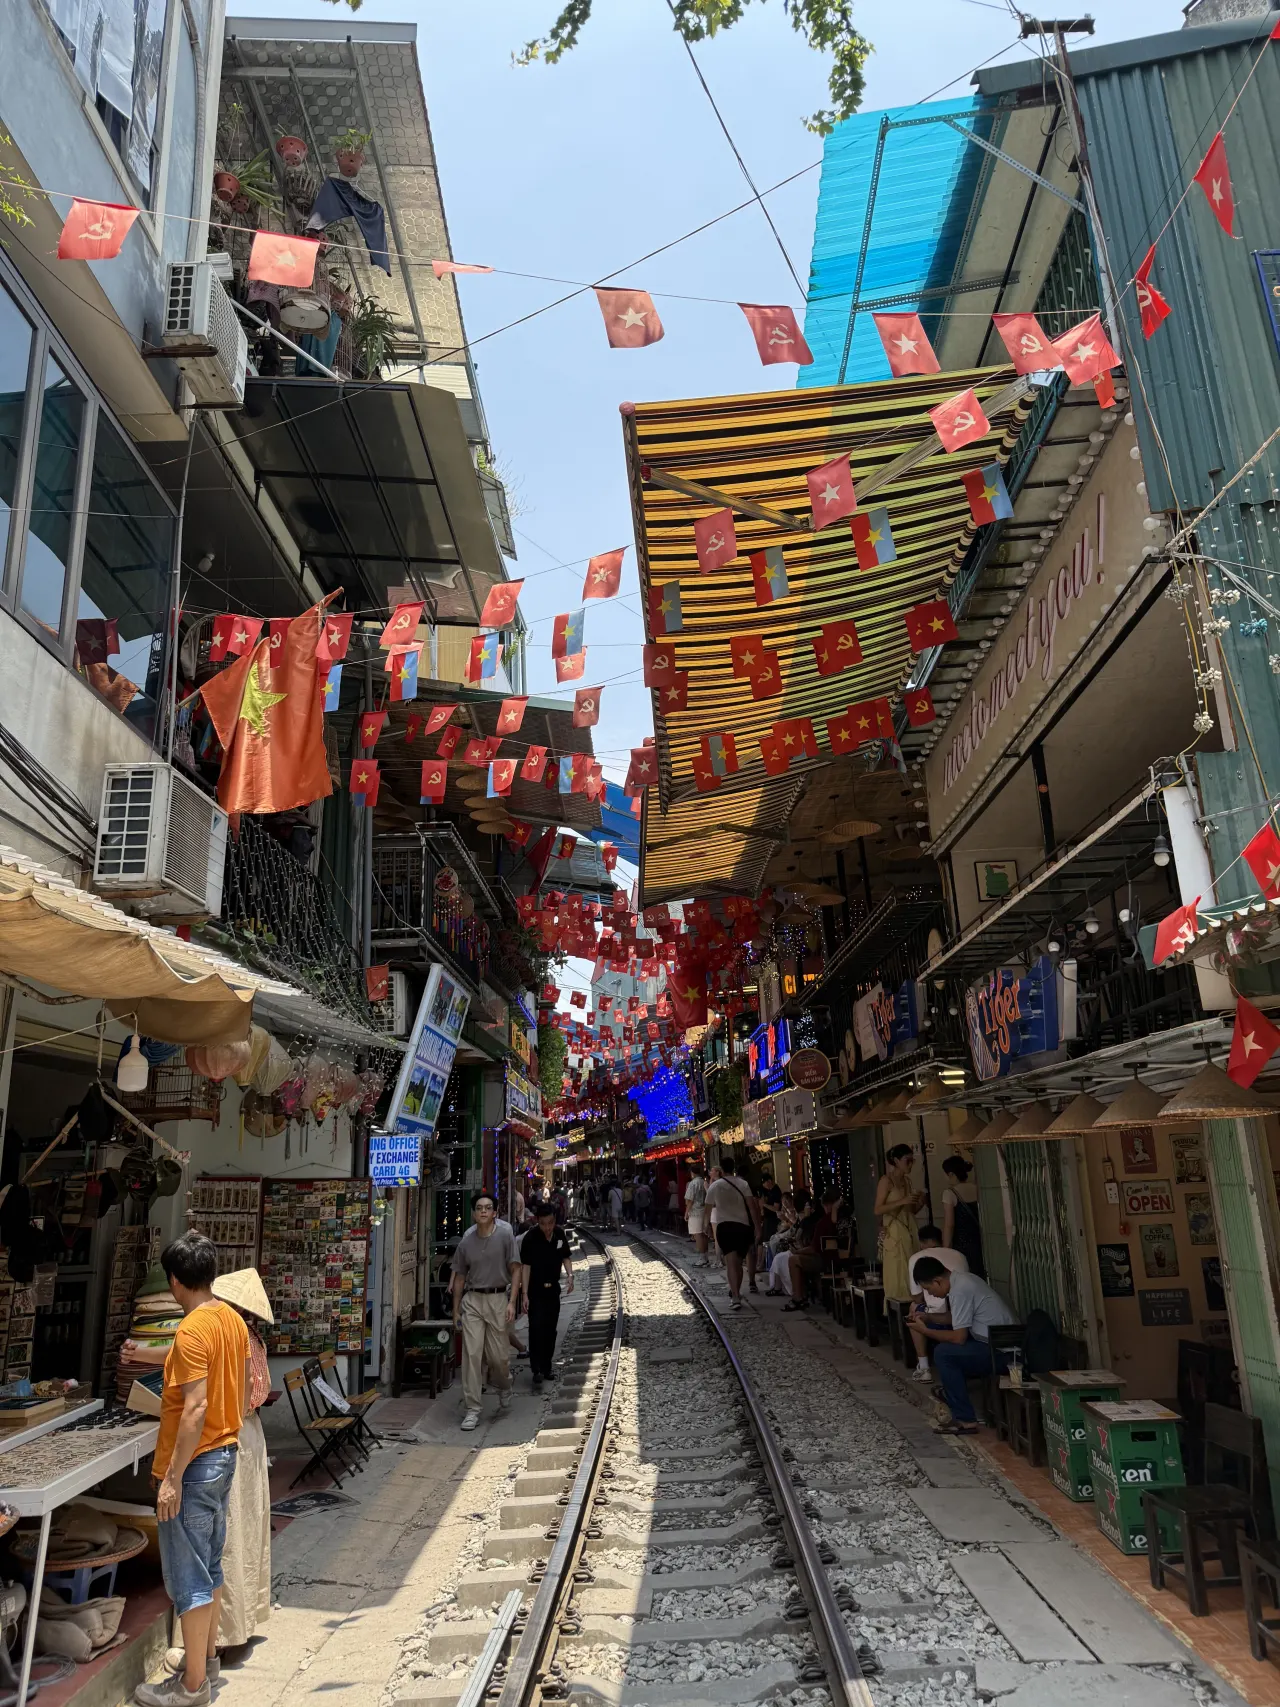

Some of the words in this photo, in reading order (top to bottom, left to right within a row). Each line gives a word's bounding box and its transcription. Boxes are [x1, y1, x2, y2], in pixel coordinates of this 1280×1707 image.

[970, 690, 990, 750] to
[989, 597, 1038, 728] meet
[1039, 492, 1105, 681] you!
[871, 990, 897, 1042] Tiger
[978, 970, 1022, 1054] Tiger
[370, 1138, 386, 1150] ING
[389, 1137, 419, 1150] OFFICE
[370, 1152, 374, 1164] Y
[377, 1151, 419, 1164] EXCHANGE
[373, 1166, 396, 1176] CARD
[399, 1165, 410, 1176] 4G
[1128, 1195, 1171, 1212] OPEN
[1144, 1233, 1171, 1241] COFFEE
[1152, 1309, 1181, 1319] LIFE
